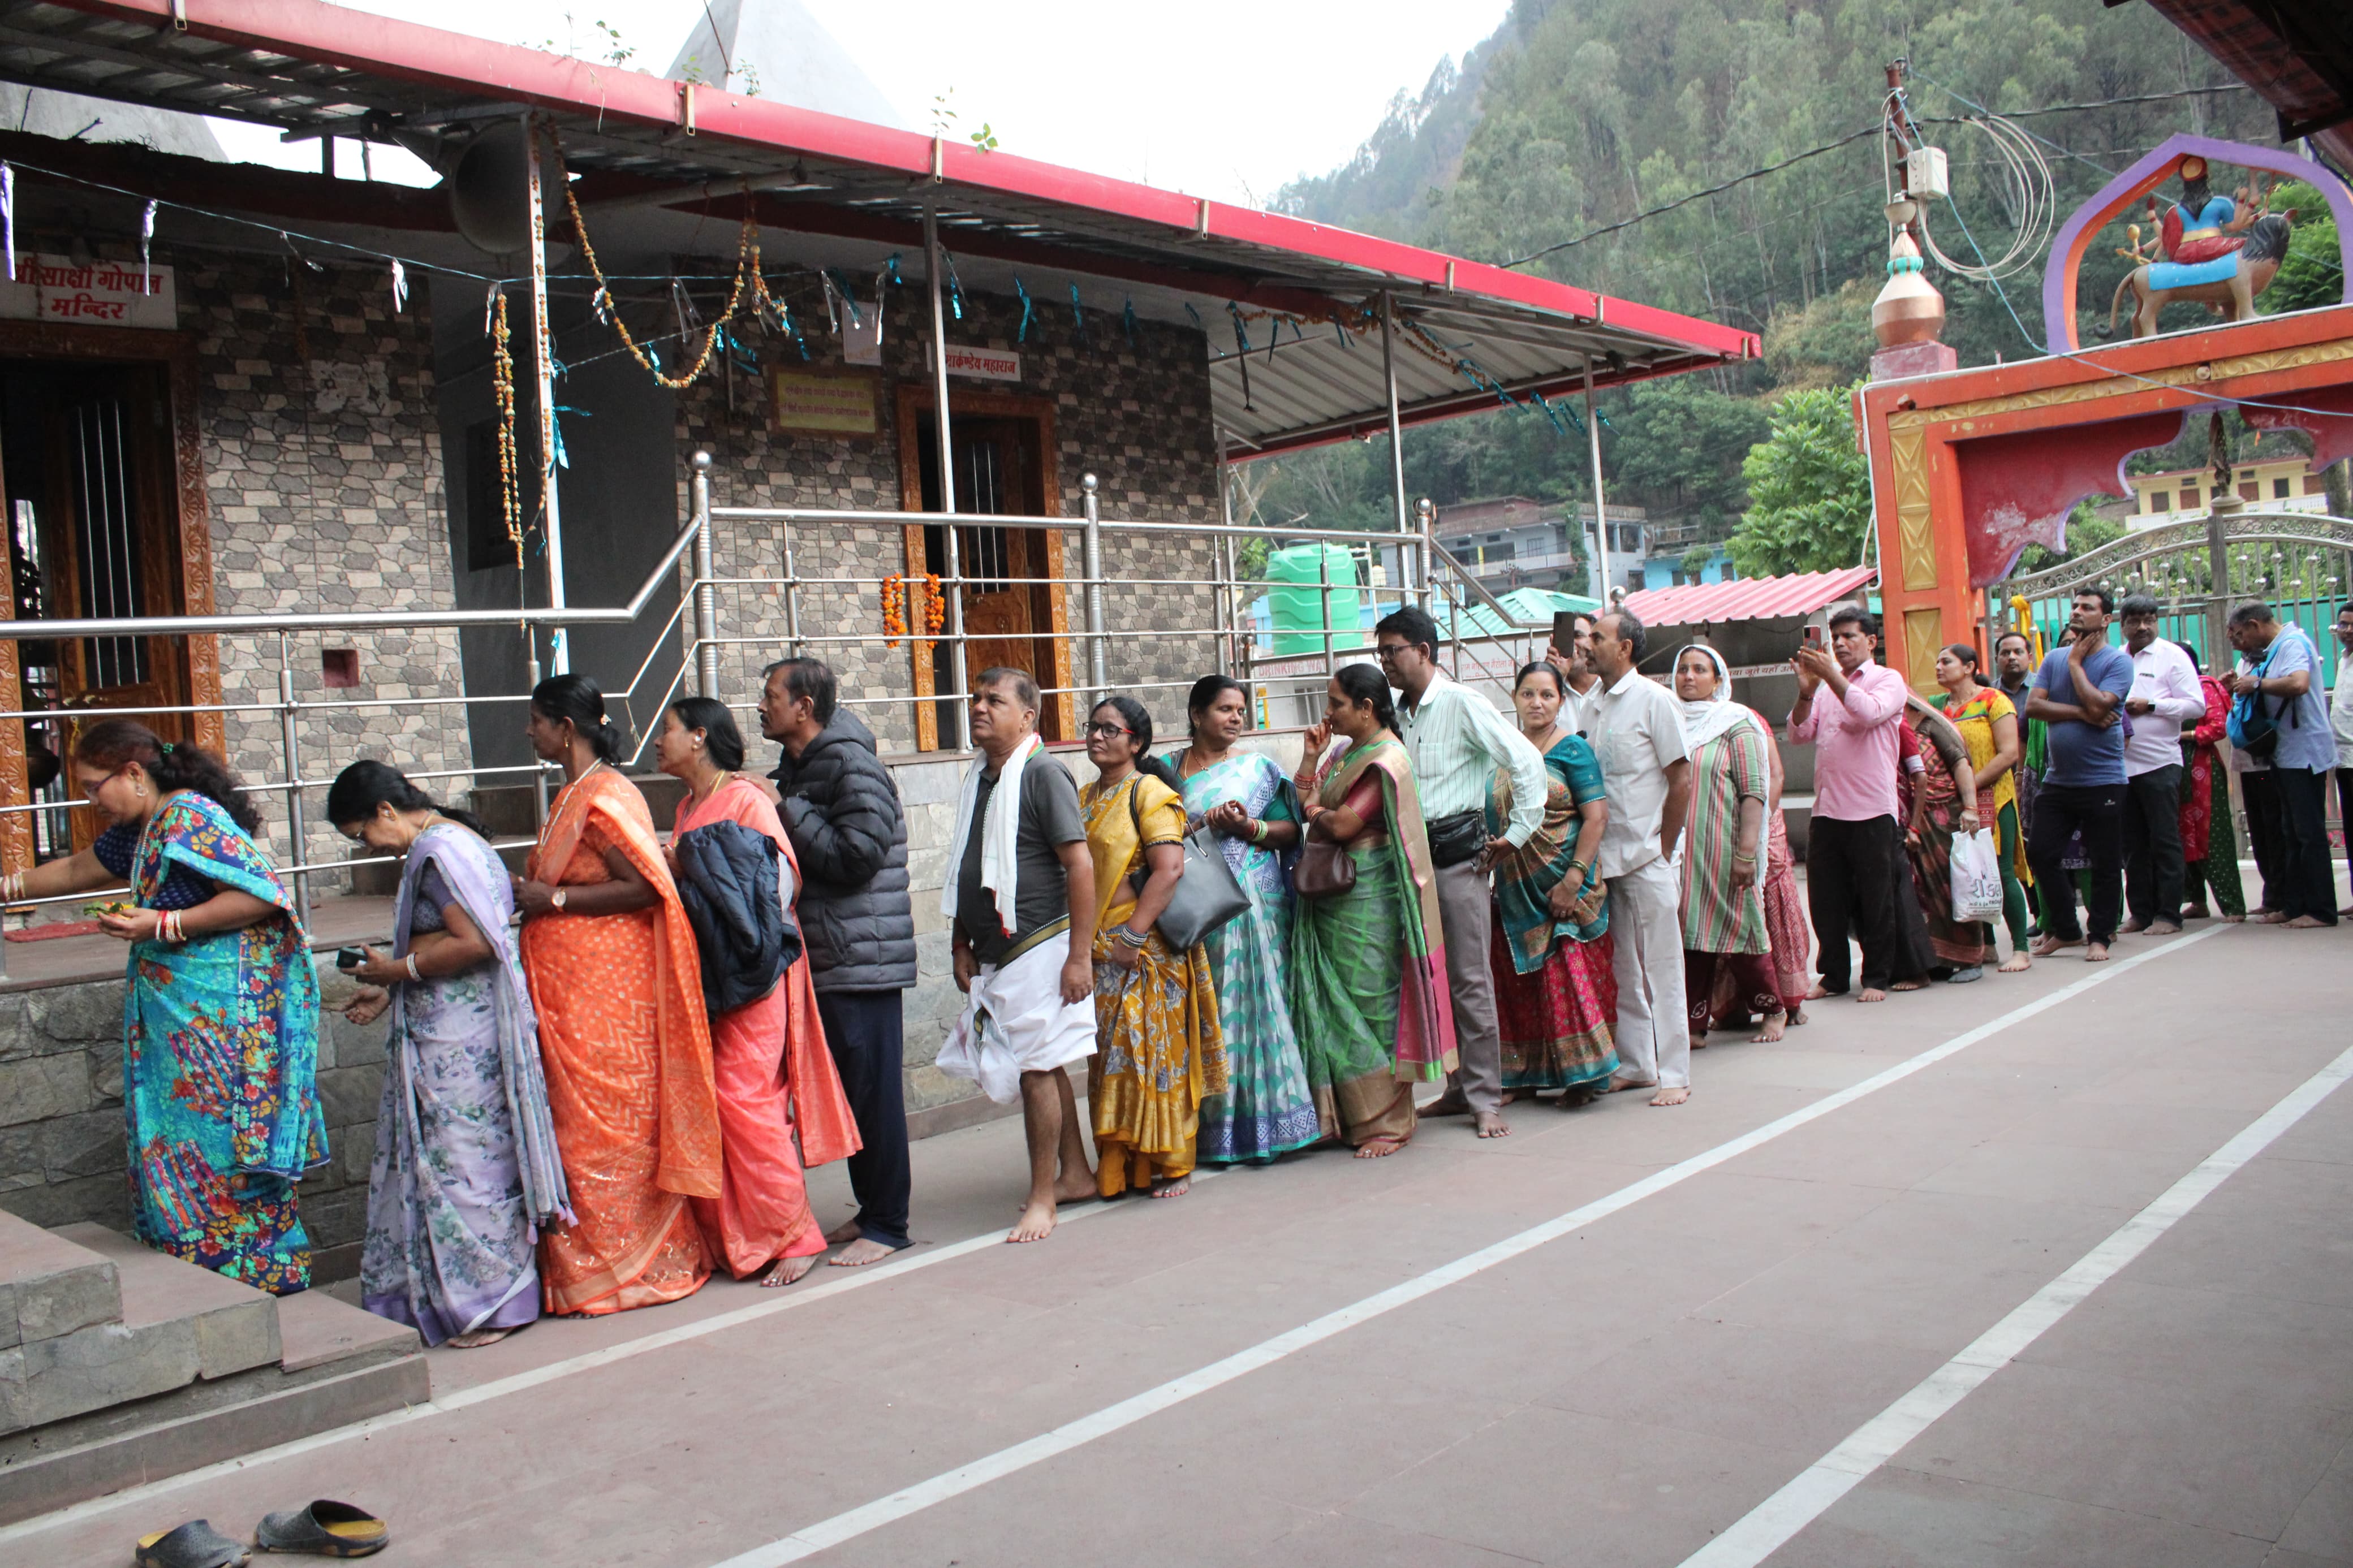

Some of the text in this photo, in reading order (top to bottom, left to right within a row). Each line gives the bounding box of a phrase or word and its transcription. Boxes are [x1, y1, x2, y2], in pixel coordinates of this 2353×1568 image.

[98, 263, 164, 295] गोपाल
[51, 292, 127, 319] मन्दिर
[983, 358, 1016, 374] महाराज
[1259, 657, 1340, 677] DRINKING WATR
